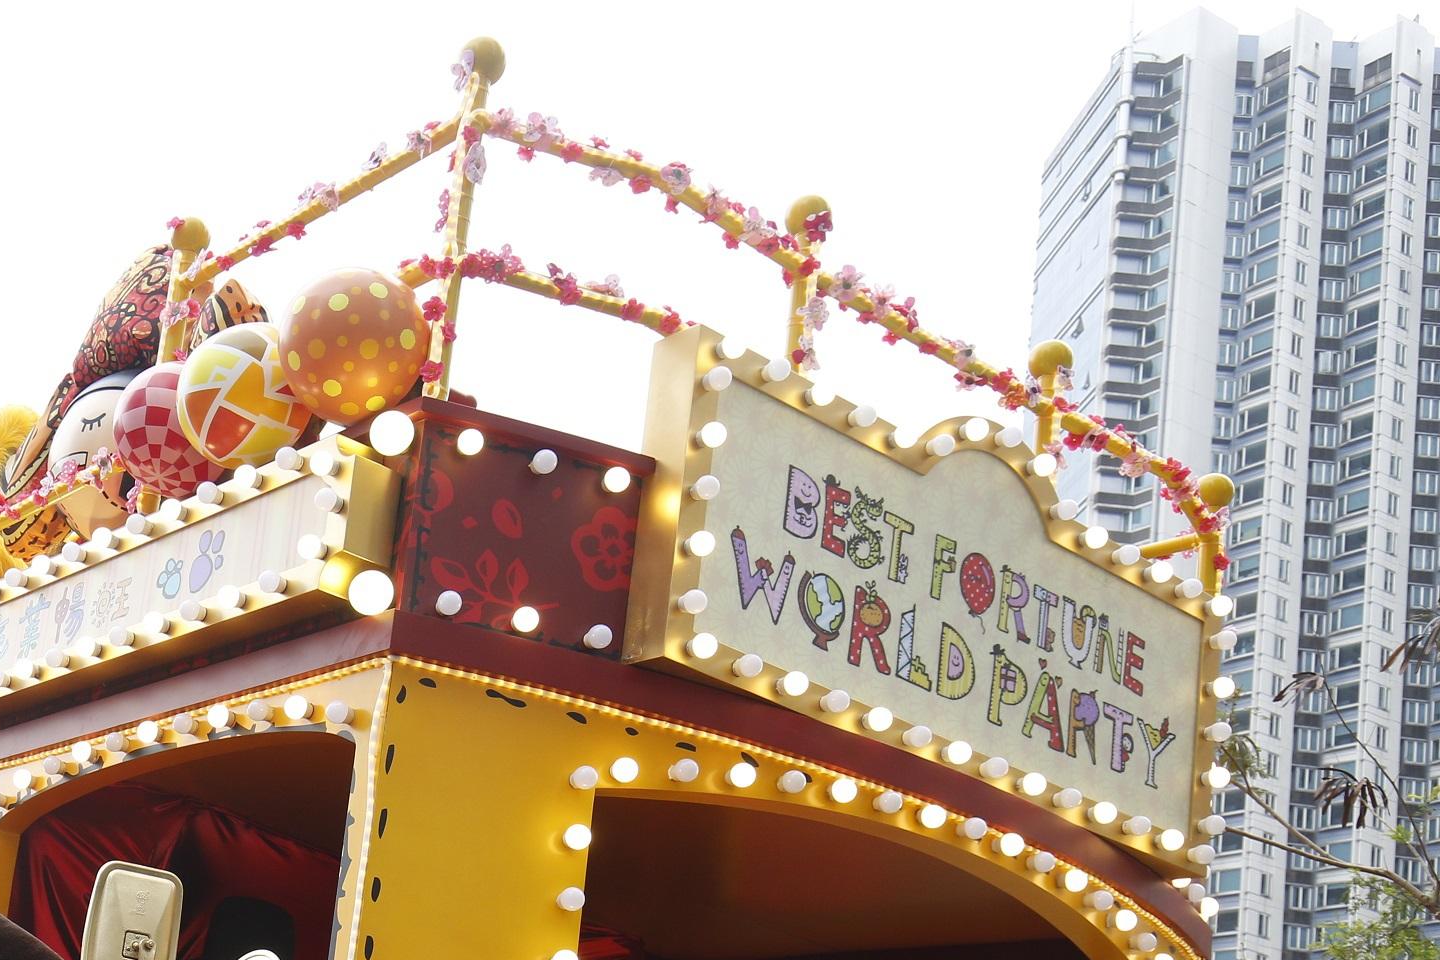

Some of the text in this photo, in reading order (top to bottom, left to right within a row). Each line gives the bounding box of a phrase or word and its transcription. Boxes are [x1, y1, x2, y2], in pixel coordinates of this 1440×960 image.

[730, 525, 1177, 789] WORLD PARTY
[783, 463, 1147, 696] BEST FORTUNE
